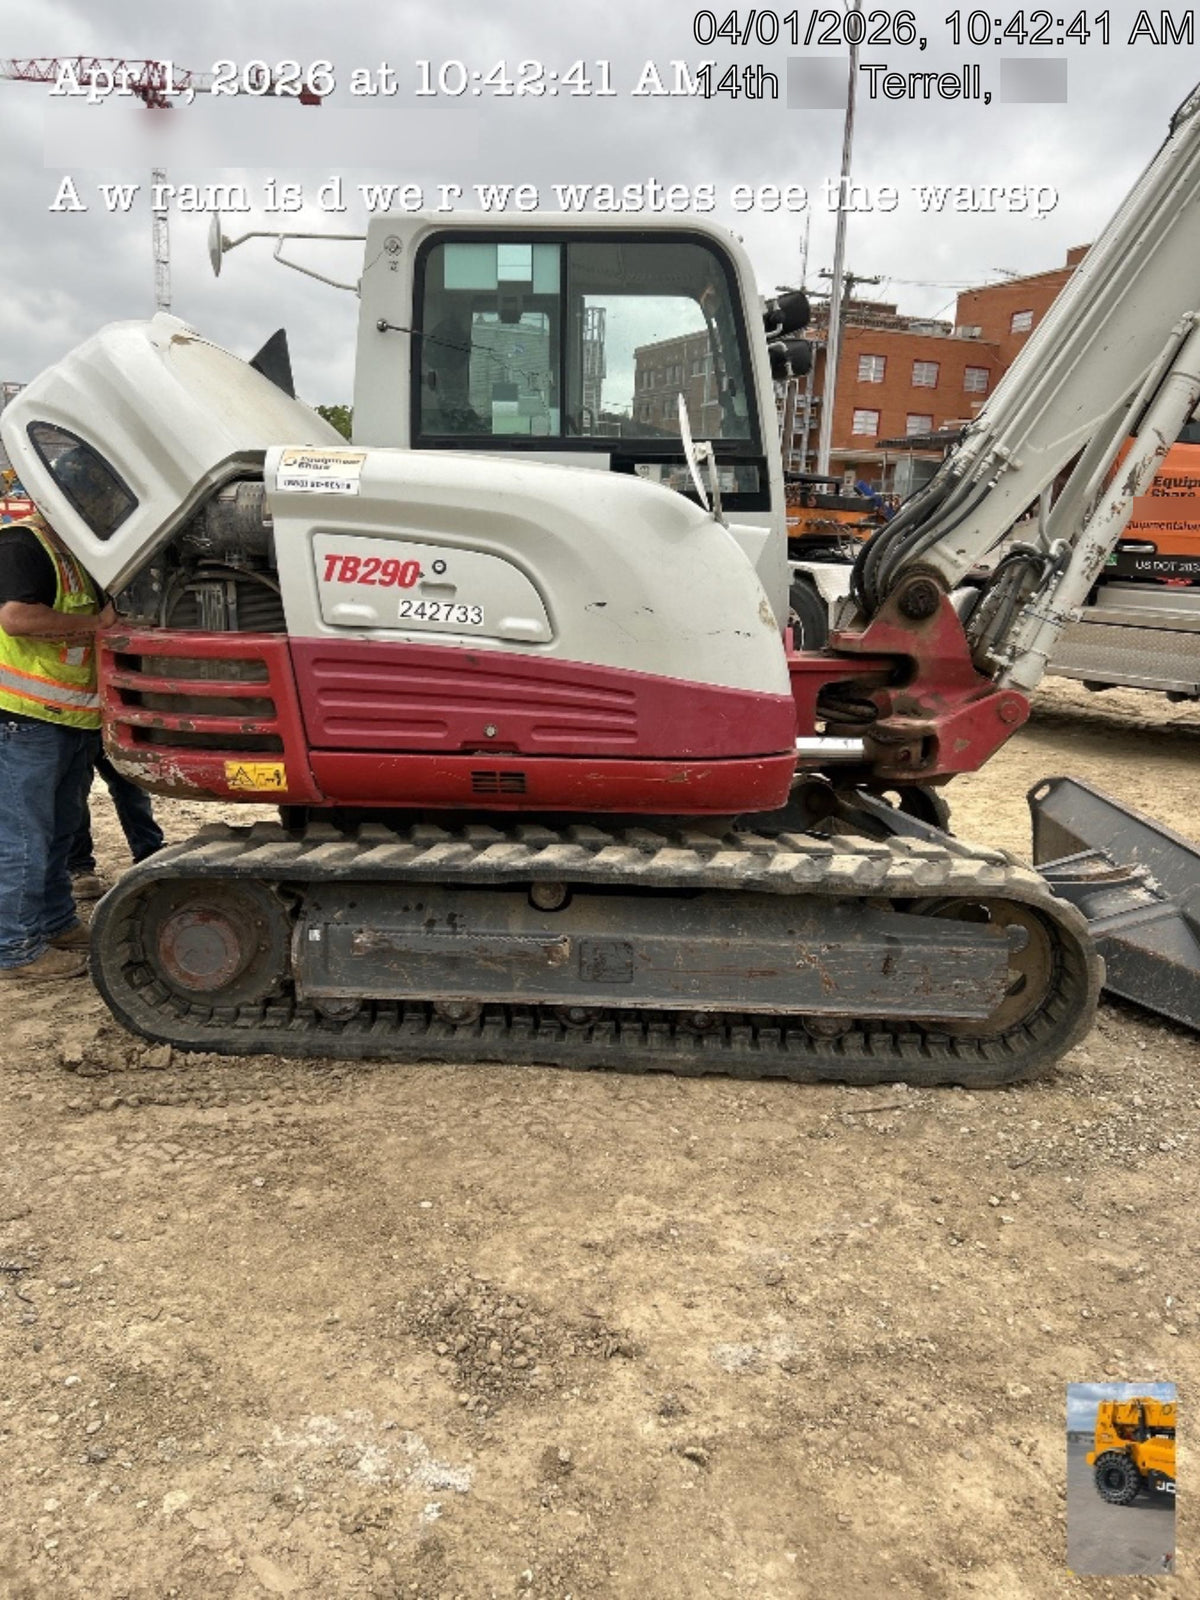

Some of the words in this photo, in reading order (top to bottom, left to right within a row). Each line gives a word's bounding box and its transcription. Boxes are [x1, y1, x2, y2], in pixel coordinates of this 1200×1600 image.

[323, 554, 421, 589] TB290
[1153, 560, 1178, 572] DOT
[400, 600, 483, 625] 242733
